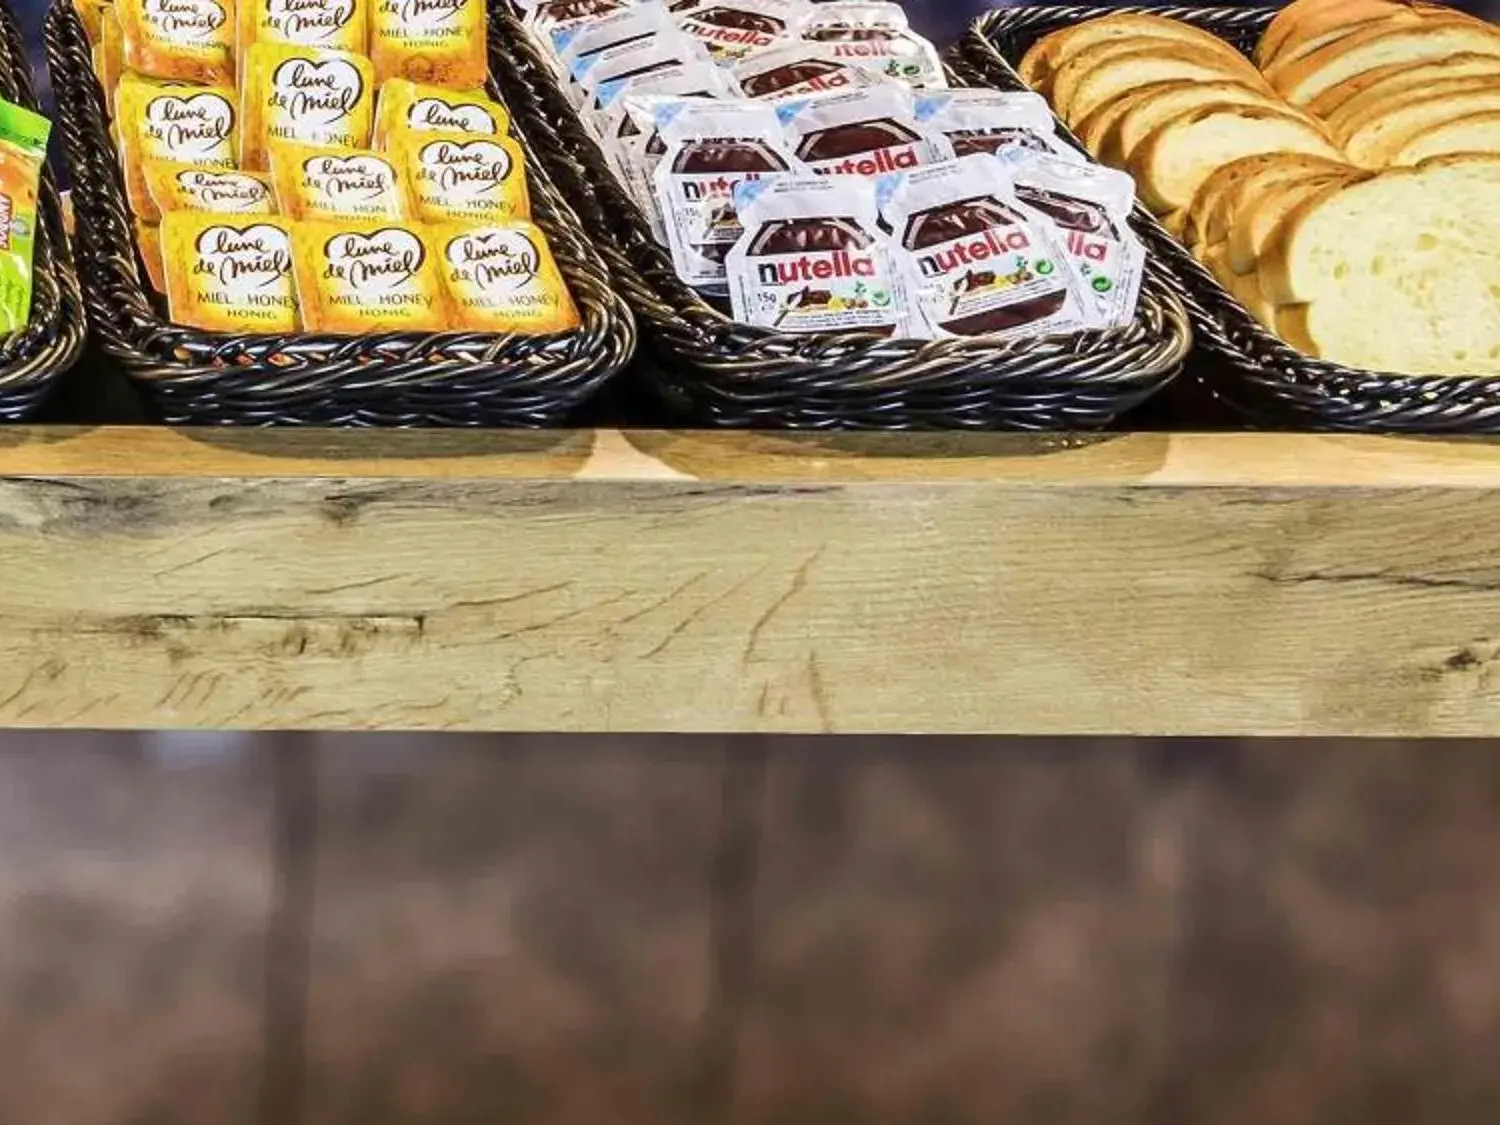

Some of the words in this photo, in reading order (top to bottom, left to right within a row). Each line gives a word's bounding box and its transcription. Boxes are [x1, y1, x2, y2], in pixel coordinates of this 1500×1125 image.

[681, 20, 775, 48] nutella
[288, 63, 342, 90] lune
[163, 99, 209, 122] lune
[290, 87, 351, 126] miel
[167, 116, 230, 151] miel
[432, 143, 490, 166] lune
[441, 162, 503, 194] miel
[215, 231, 267, 254] lune
[341, 237, 400, 259] lune
[463, 239, 517, 263] lune
[915, 226, 1033, 279] nutella
[193, 258, 215, 275] de
[219, 250, 291, 287] miel
[323, 262, 346, 281] de
[349, 250, 414, 289] miel
[474, 251, 535, 291] miel
[757, 250, 877, 285] nutella
[197, 291, 233, 305] MIEL
[329, 293, 362, 306] MIEL
[378, 293, 434, 309] HONEY
